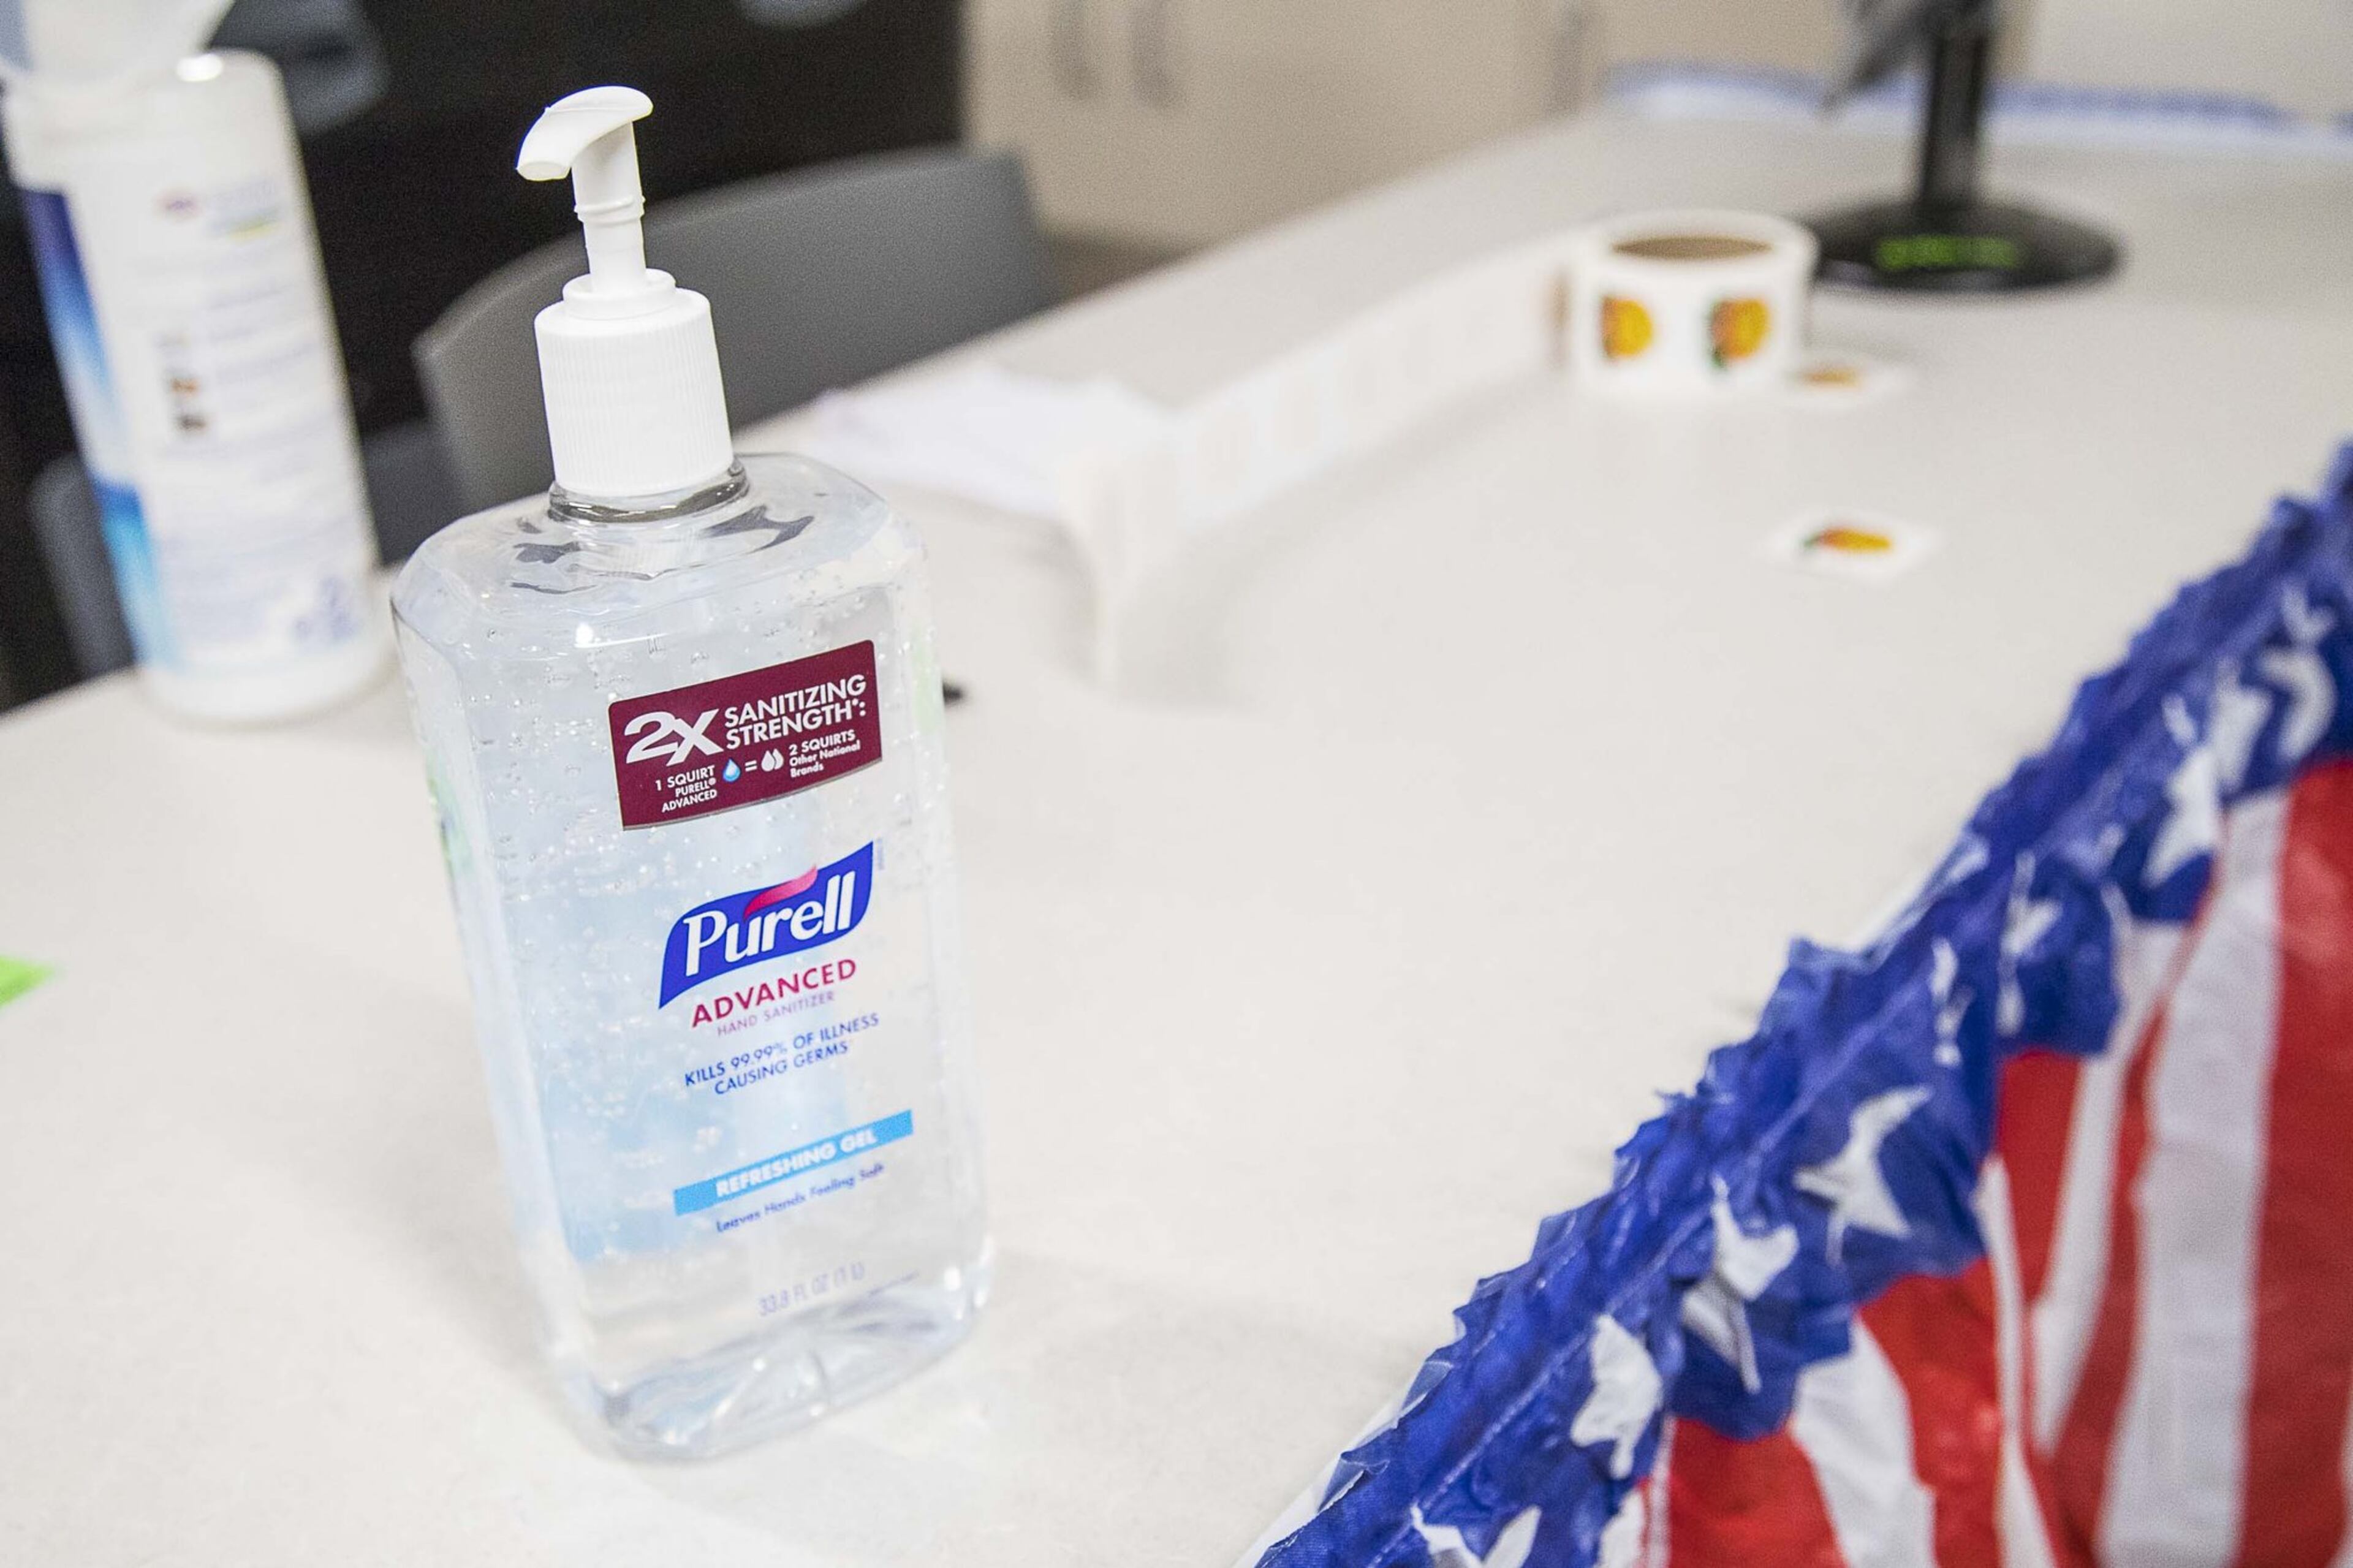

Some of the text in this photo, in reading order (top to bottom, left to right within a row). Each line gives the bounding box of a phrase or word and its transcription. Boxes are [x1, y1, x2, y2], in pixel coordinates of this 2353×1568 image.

[725, 675, 866, 727] SANITIZING
[624, 709, 724, 767] 2X
[789, 729, 856, 756] 2 SQUIRTS
[789, 740, 861, 767] Other National
[655, 765, 715, 791] 1 SQUIRT
[790, 761, 824, 778] Brands
[662, 789, 718, 812] ADVANCED
[683, 871, 855, 976] Purell
[692, 959, 856, 1028] ADVANCED
[717, 991, 835, 1036] HAND SANITIZER
[684, 1013, 879, 1086] KILLS 99.99% OF ILLNESS
[714, 1041, 848, 1094] CAUSING GERMS
[716, 1129, 877, 1197] REFRESHING GEL
[716, 1163, 884, 1232] Leaves Hands Feeling Soft
